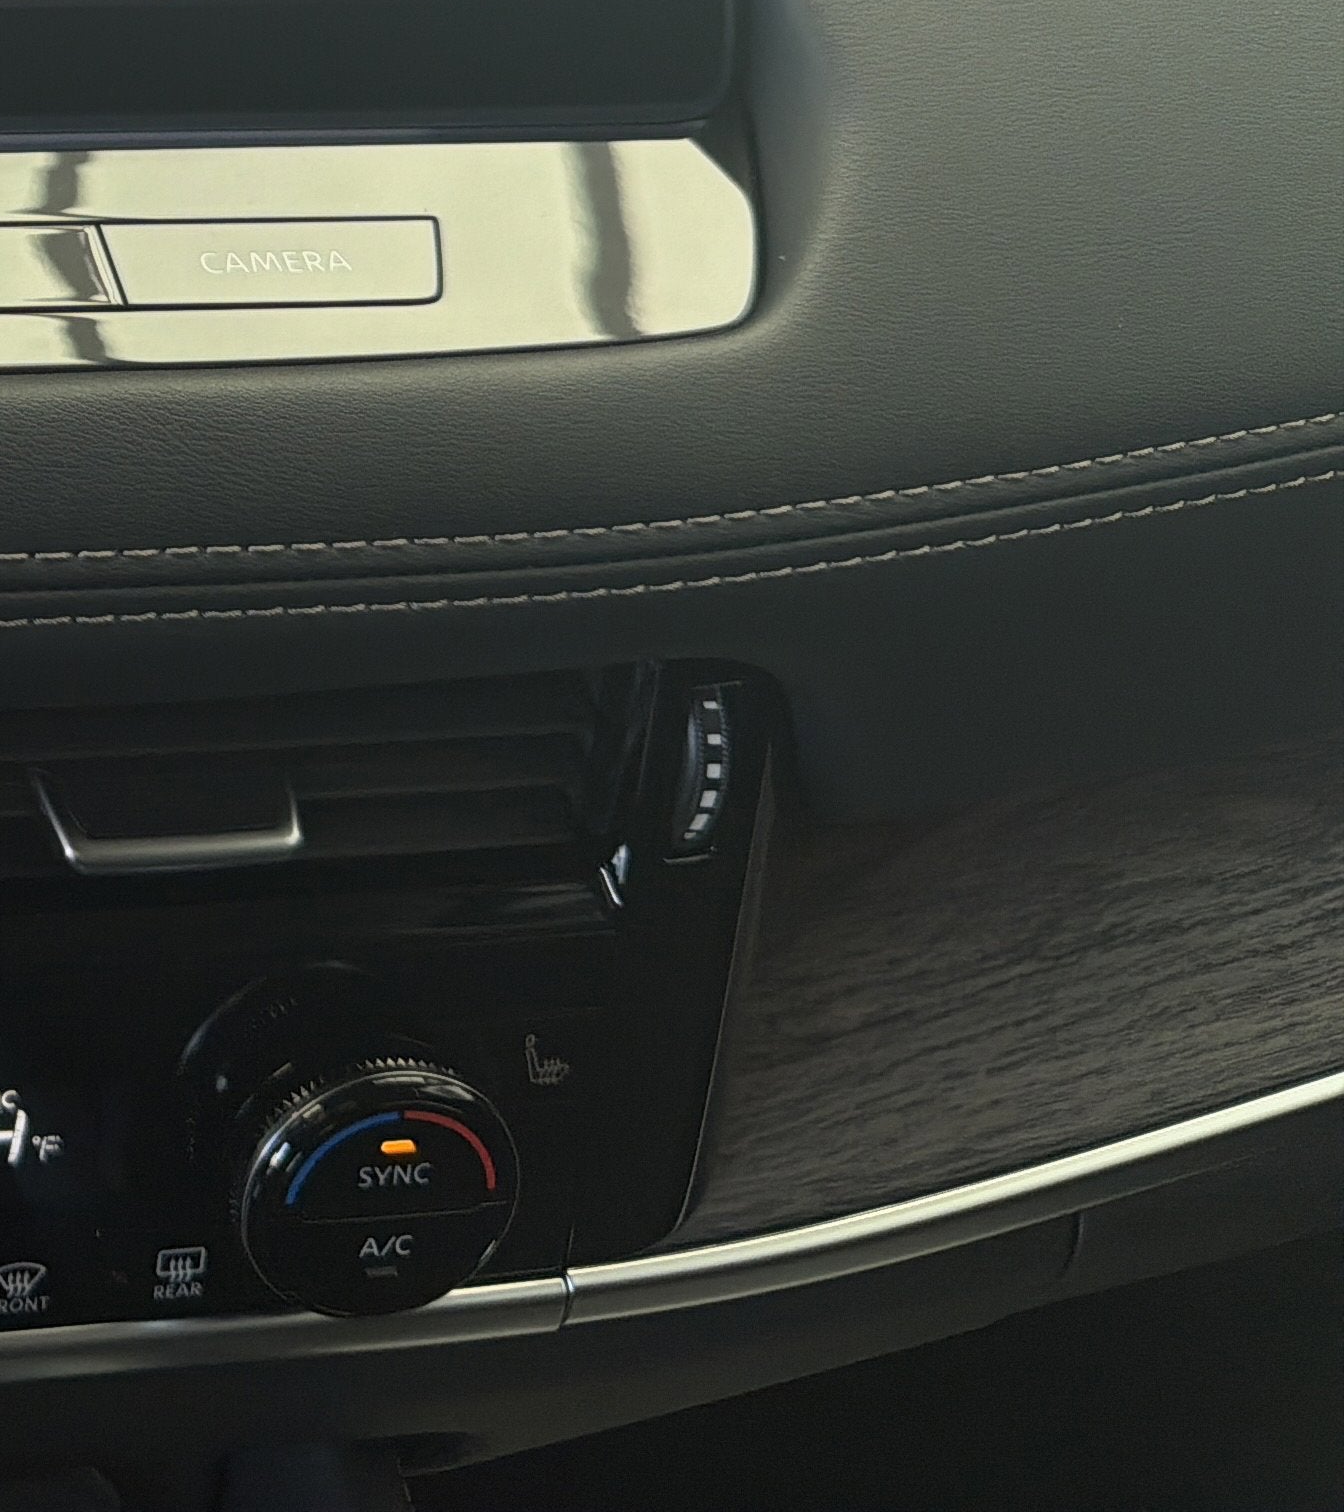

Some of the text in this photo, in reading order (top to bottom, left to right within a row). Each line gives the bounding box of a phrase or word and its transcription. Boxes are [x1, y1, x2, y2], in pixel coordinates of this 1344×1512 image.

[199, 247, 354, 278] CAMERA
[357, 1162, 433, 1189] SYNC
[359, 1234, 413, 1259] A/C
[153, 1281, 203, 1301] REAR
